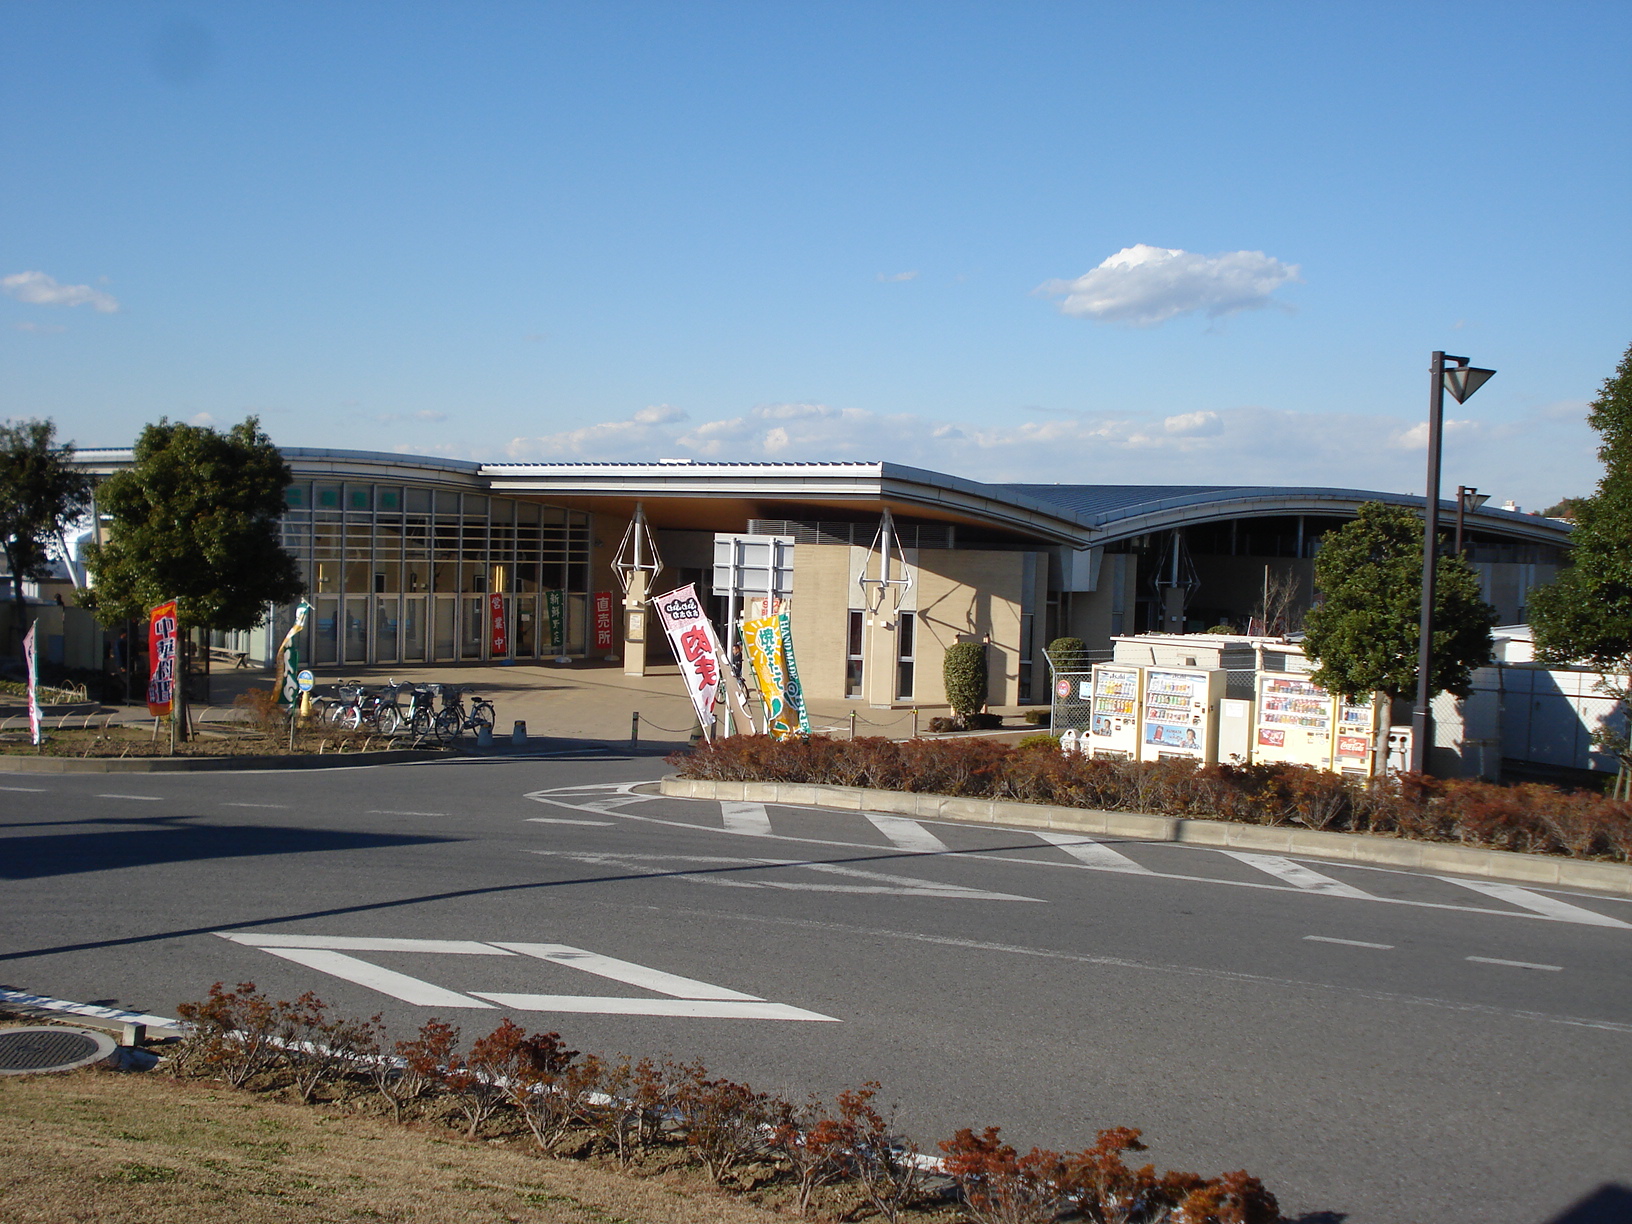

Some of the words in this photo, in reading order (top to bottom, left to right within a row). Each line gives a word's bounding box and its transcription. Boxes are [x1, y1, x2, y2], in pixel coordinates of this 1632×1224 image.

[491, 596, 504, 650] 営業中
[549, 593, 561, 644] 新鮮野菜
[597, 596, 611, 645] 直売所
[780, 620, 793, 651] HAND
[758, 627, 784, 691] 焼きたて
[785, 652, 798, 680] MADE
